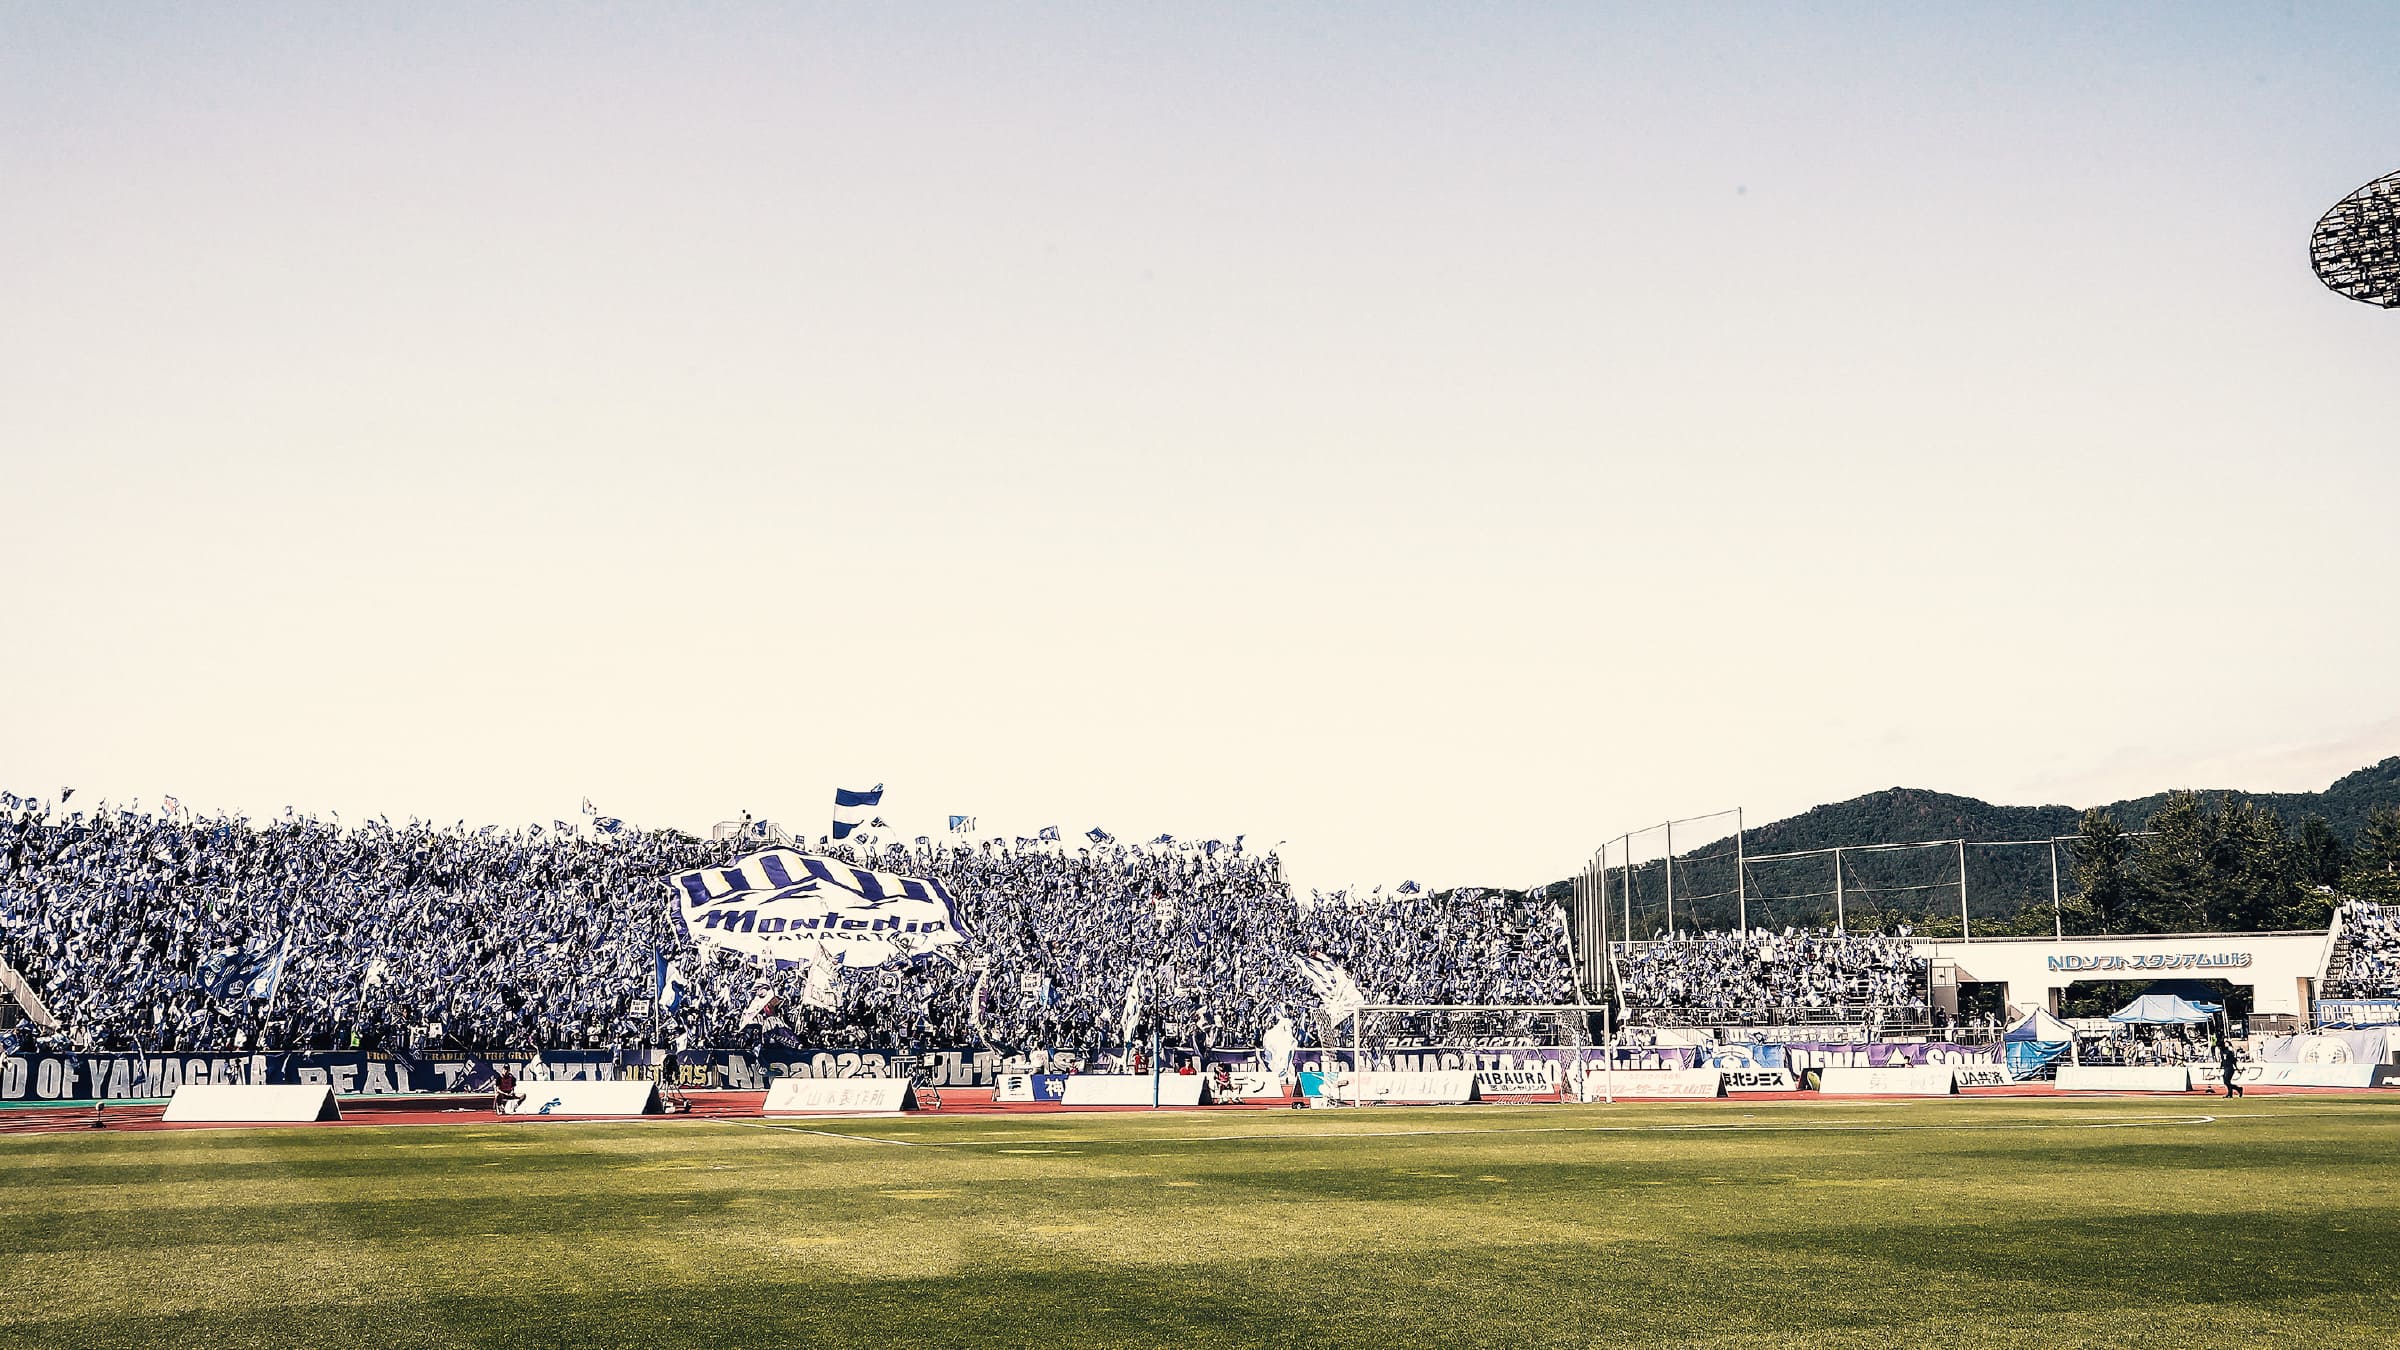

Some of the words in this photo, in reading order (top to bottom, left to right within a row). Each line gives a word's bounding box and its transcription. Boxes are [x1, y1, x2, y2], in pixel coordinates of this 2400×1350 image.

[695, 909, 945, 933] Montedio
[758, 931, 893, 942] YAMAGAT
[2047, 952, 2252, 971] NDソフトスタジアム山形
[37, 1058, 80, 1099] OF
[88, 1055, 267, 1098] YAMAGATA
